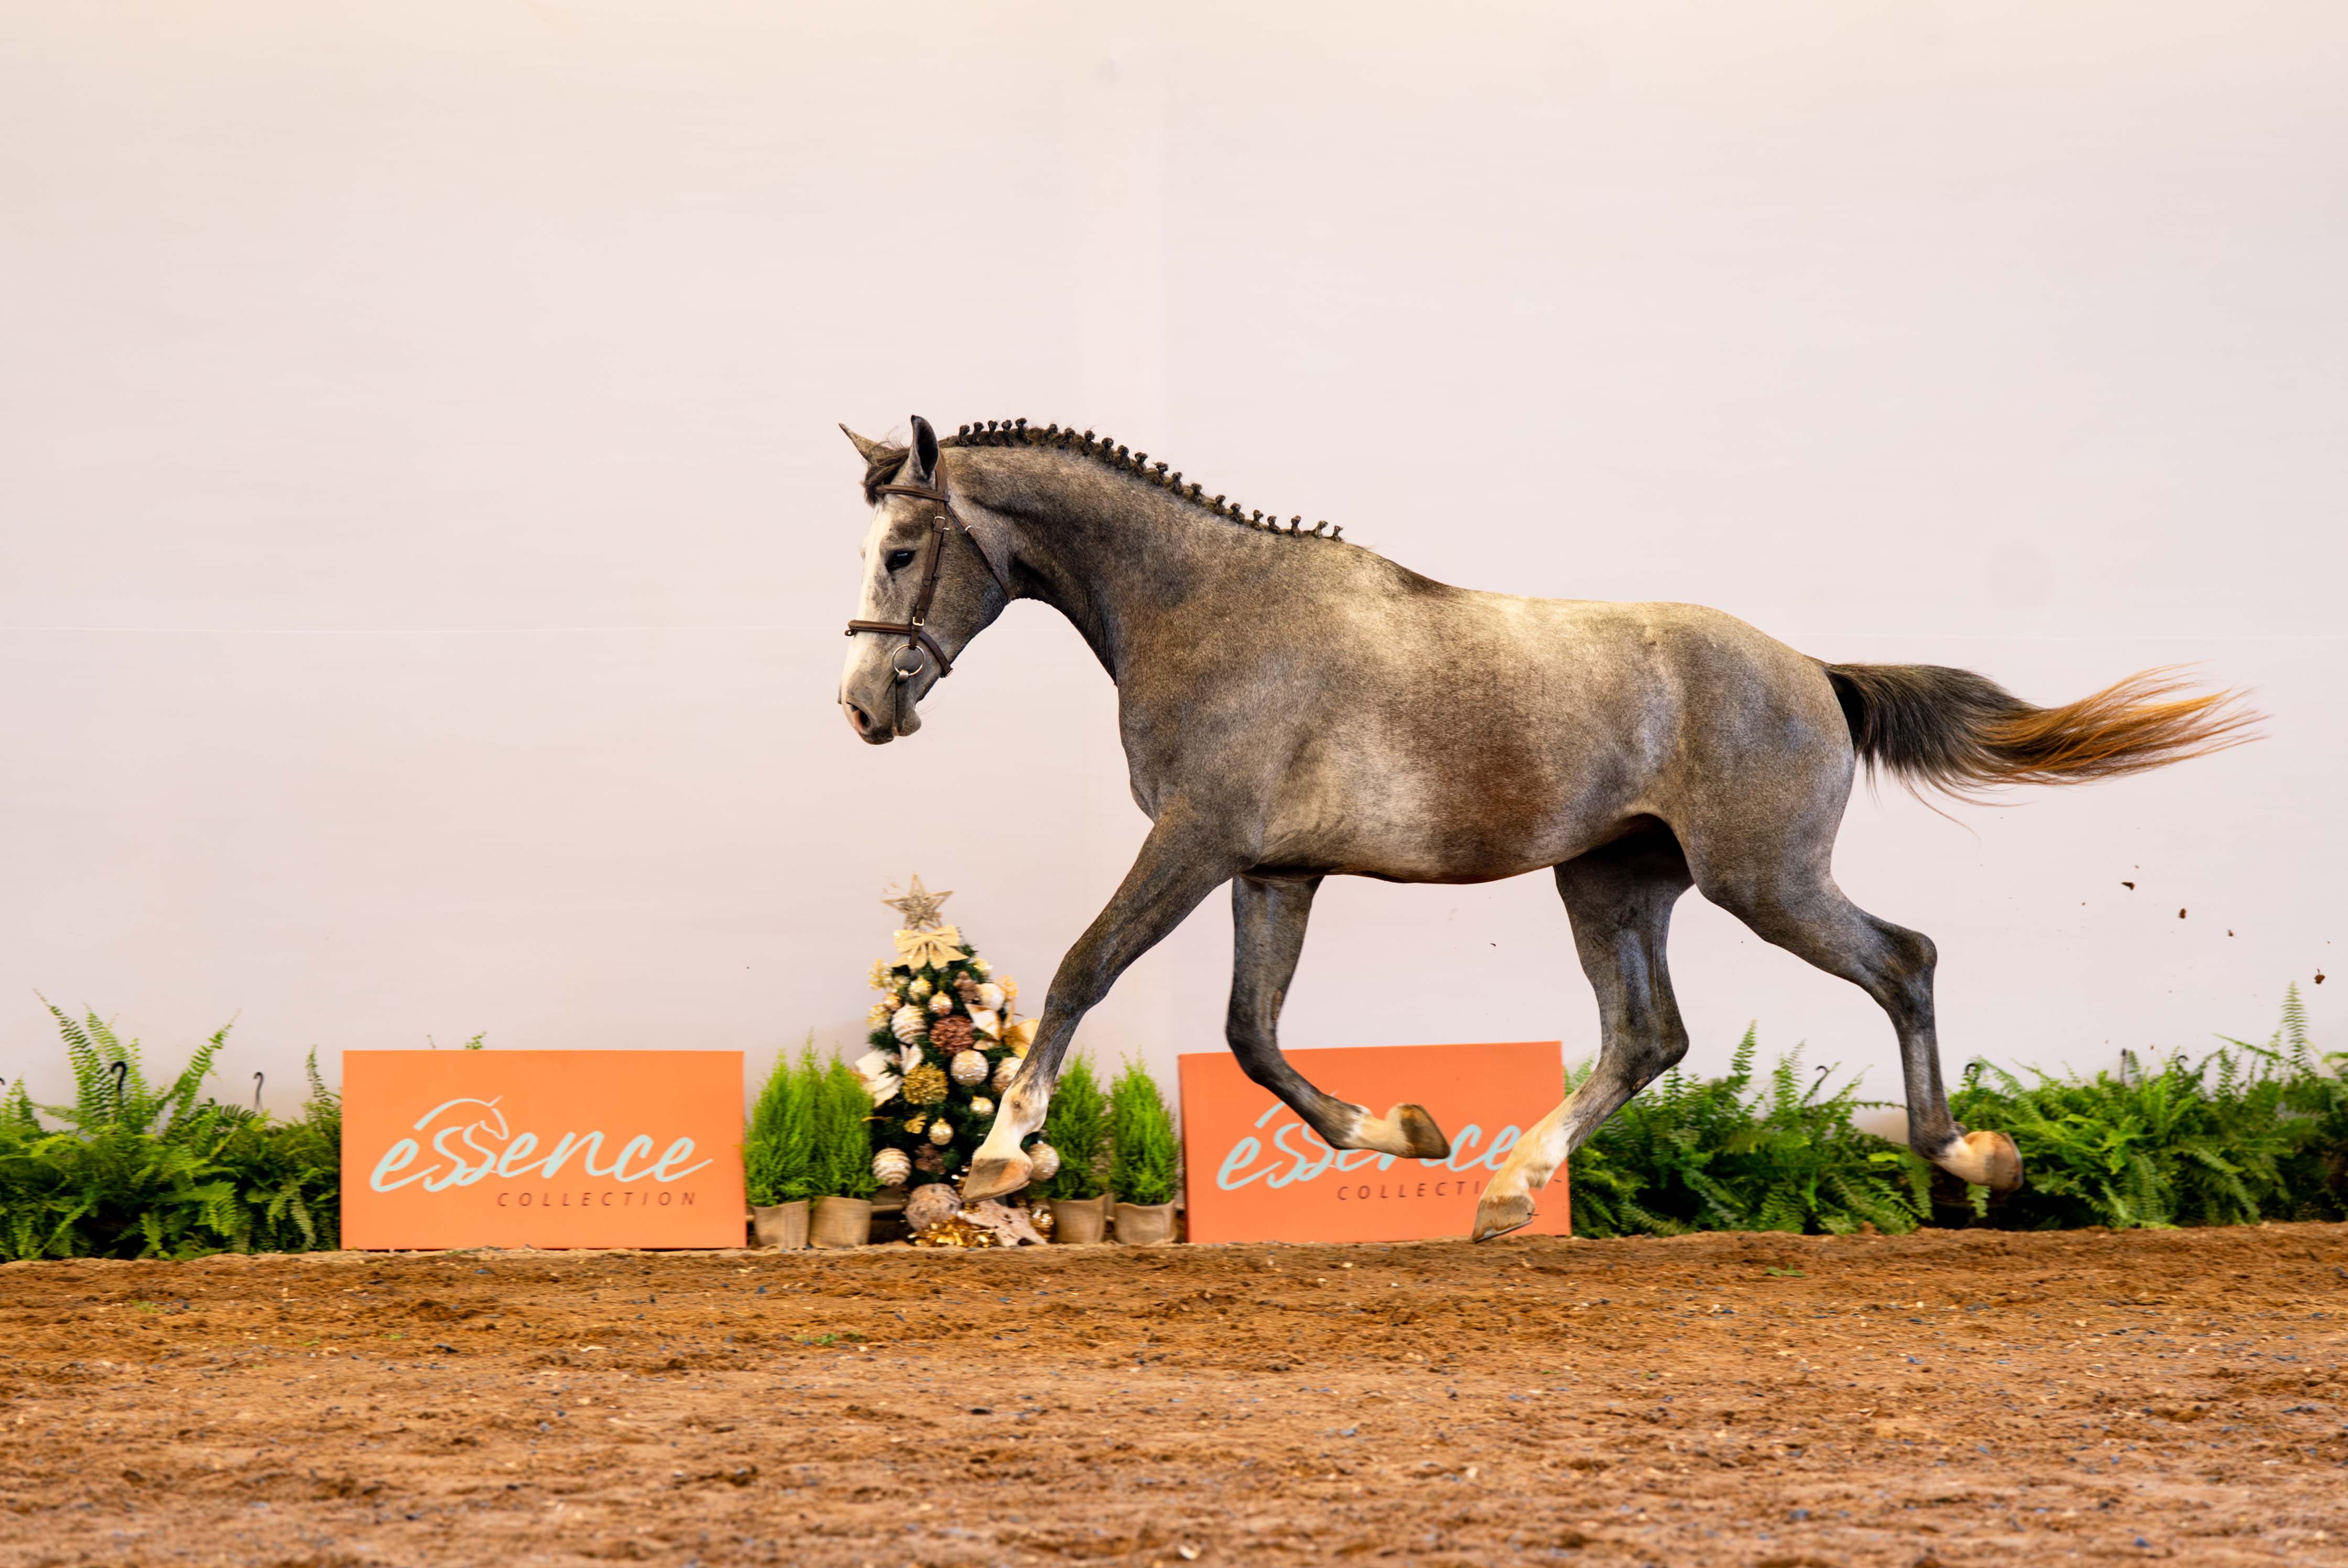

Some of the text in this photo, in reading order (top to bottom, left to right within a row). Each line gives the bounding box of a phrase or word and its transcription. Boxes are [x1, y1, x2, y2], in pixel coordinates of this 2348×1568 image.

[370, 1123, 713, 1192] essence
[1216, 1123, 1521, 1191] essce
[497, 1192, 697, 1207] COLLECTION
[1337, 1180, 1480, 1201] COLLECTI
